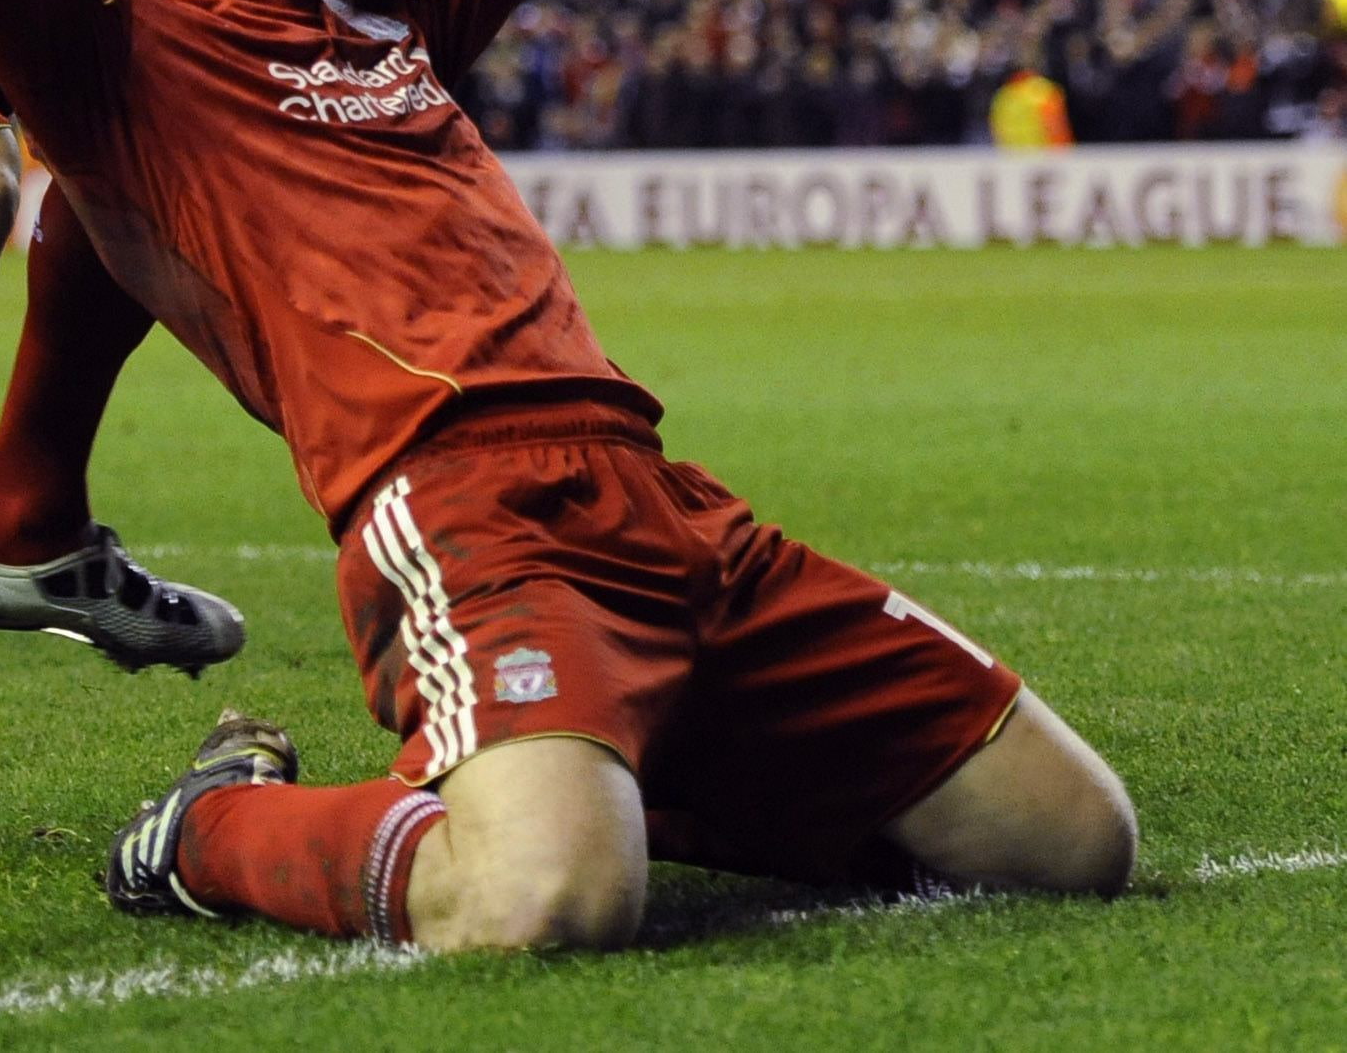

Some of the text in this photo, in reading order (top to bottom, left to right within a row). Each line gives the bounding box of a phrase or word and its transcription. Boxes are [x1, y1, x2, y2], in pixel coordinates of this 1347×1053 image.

[528, 163, 1304, 248] FA EUROPA LEAGUE
